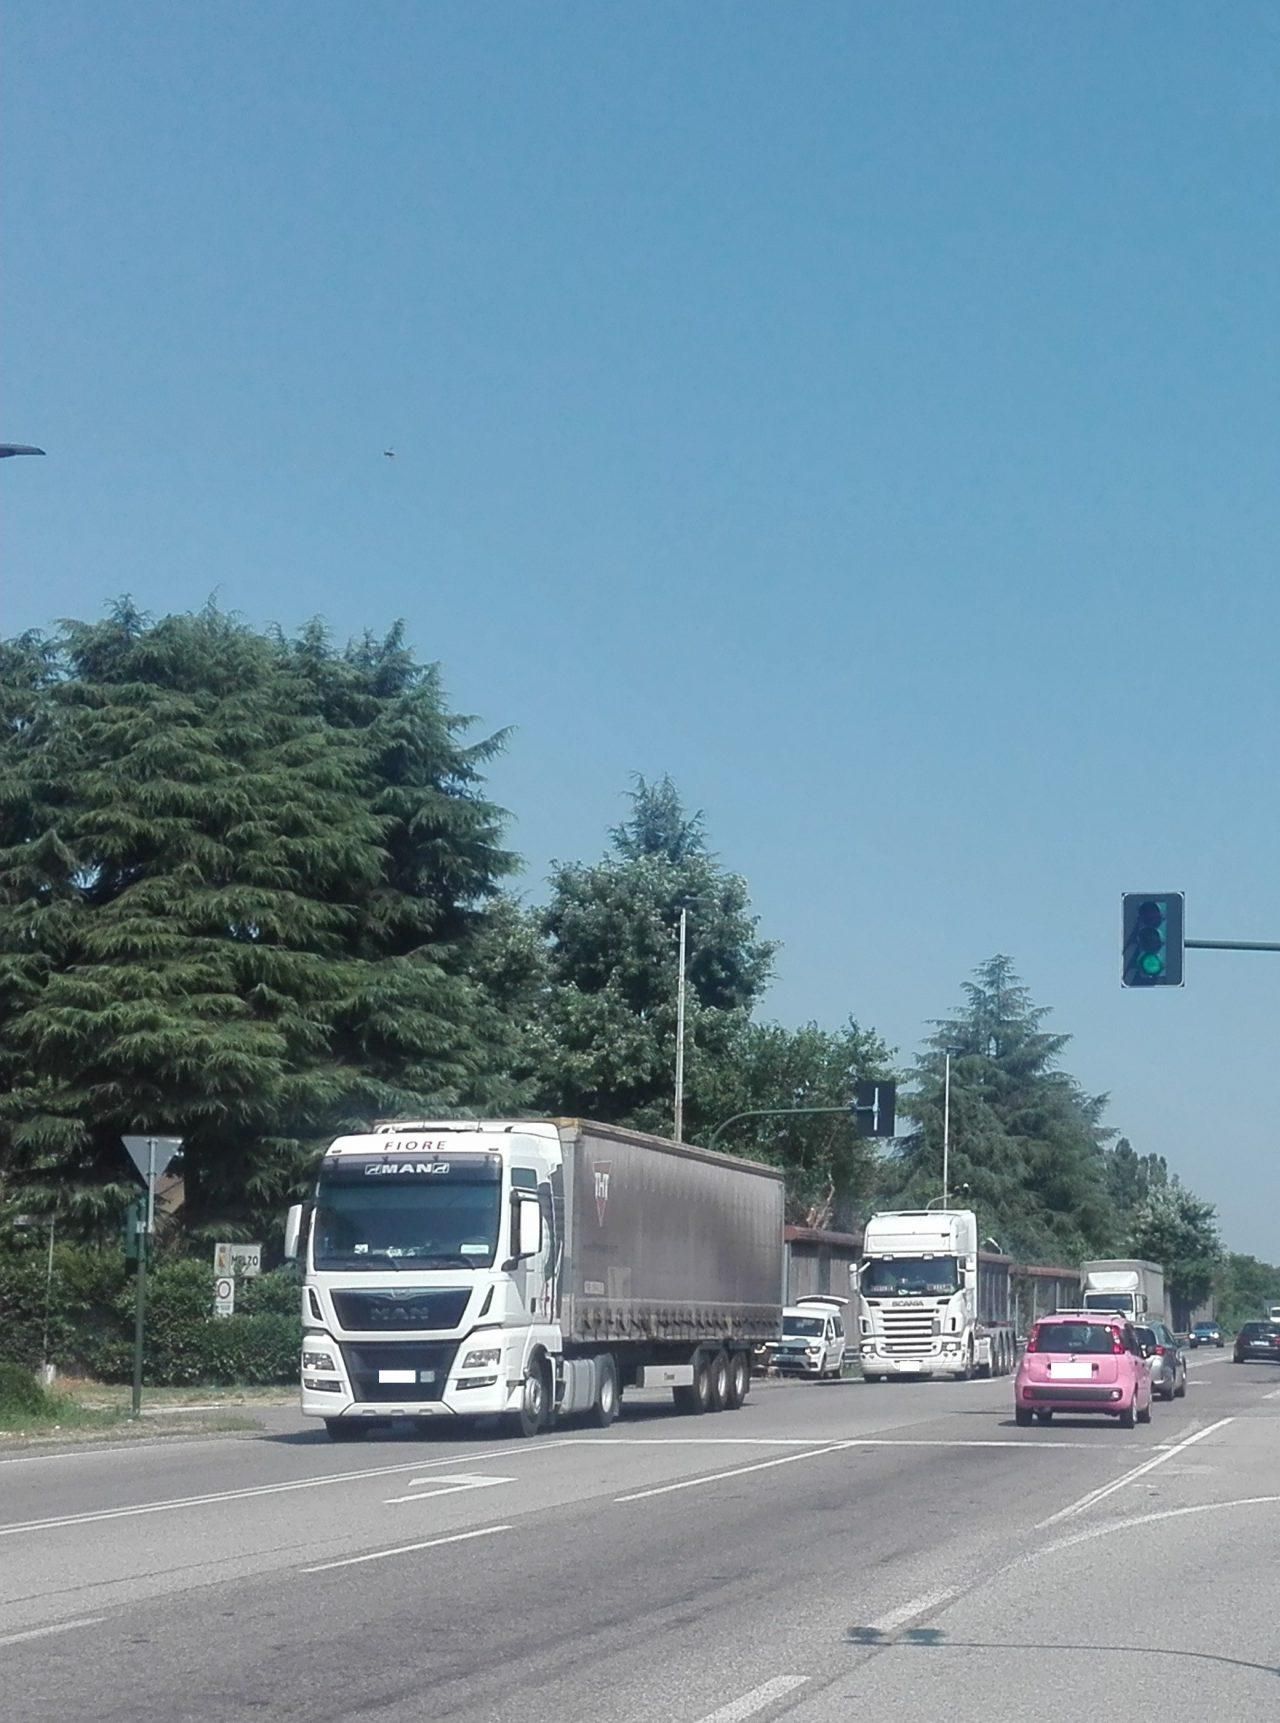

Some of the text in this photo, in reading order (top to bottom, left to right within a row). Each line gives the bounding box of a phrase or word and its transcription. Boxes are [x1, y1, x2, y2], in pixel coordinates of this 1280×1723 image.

[384, 1141, 448, 1151] FIORE
[382, 1163, 432, 1174] MAN
[370, 1307, 429, 1320] MAN
